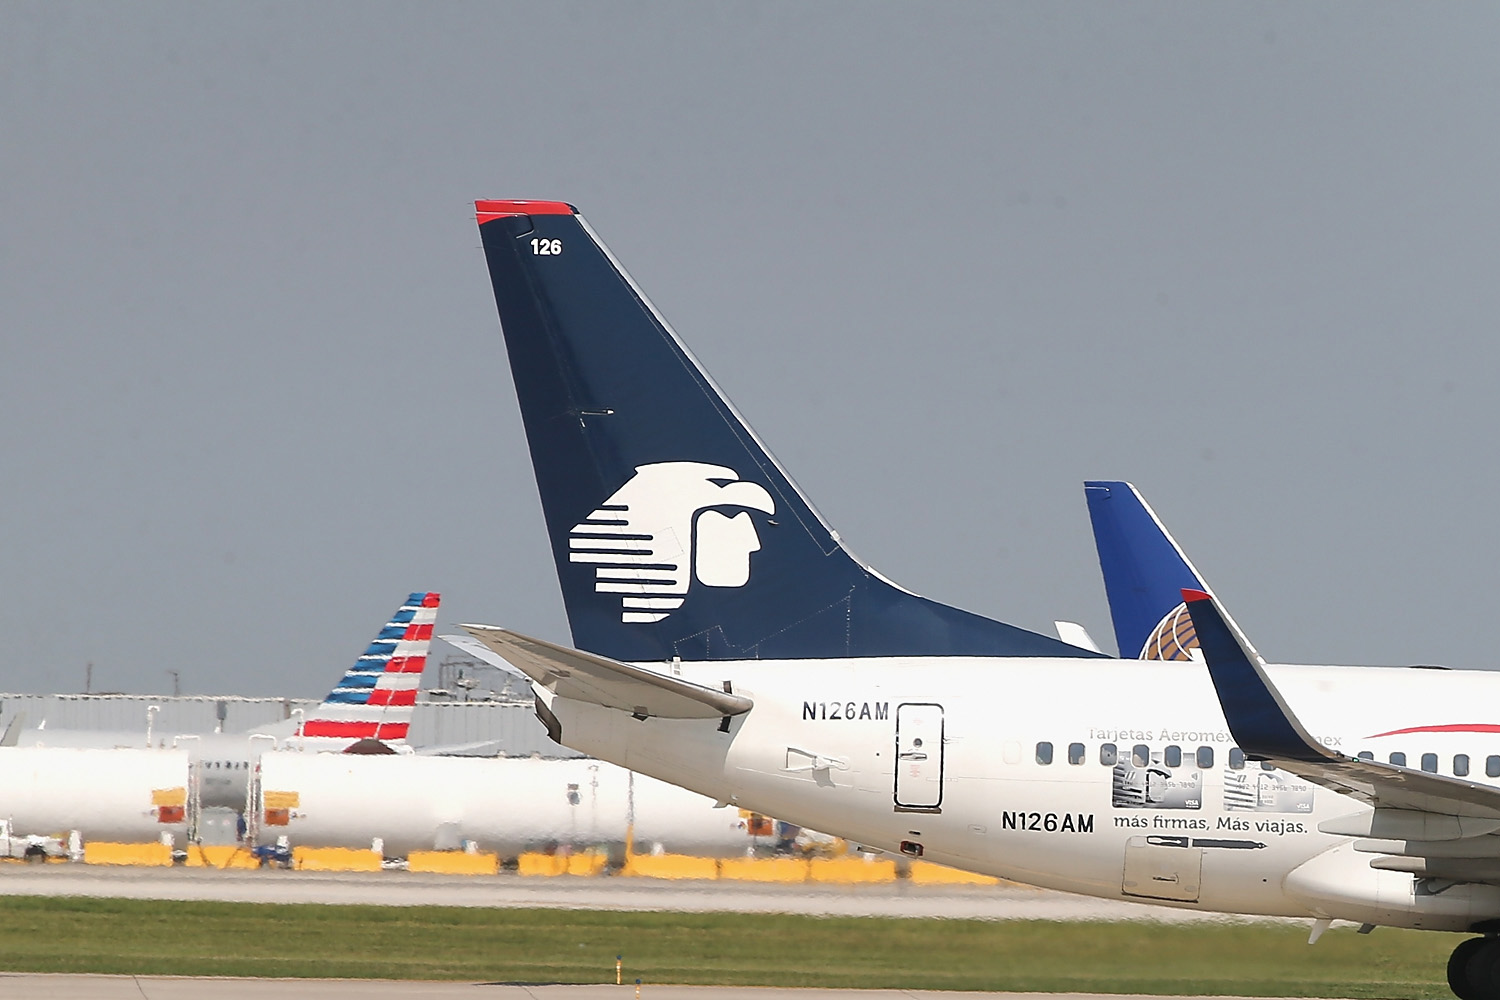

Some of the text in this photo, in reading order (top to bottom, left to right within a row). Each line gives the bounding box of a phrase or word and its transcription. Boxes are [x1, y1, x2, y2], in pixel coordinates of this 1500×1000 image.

[530, 238, 562, 256] 126
[802, 701, 889, 721] N126AM
[1087, 727, 1154, 743] Tarjetas
[1002, 811, 1094, 833] N126AM
[1113, 815, 1308, 836] más firmas, Más viajas.
